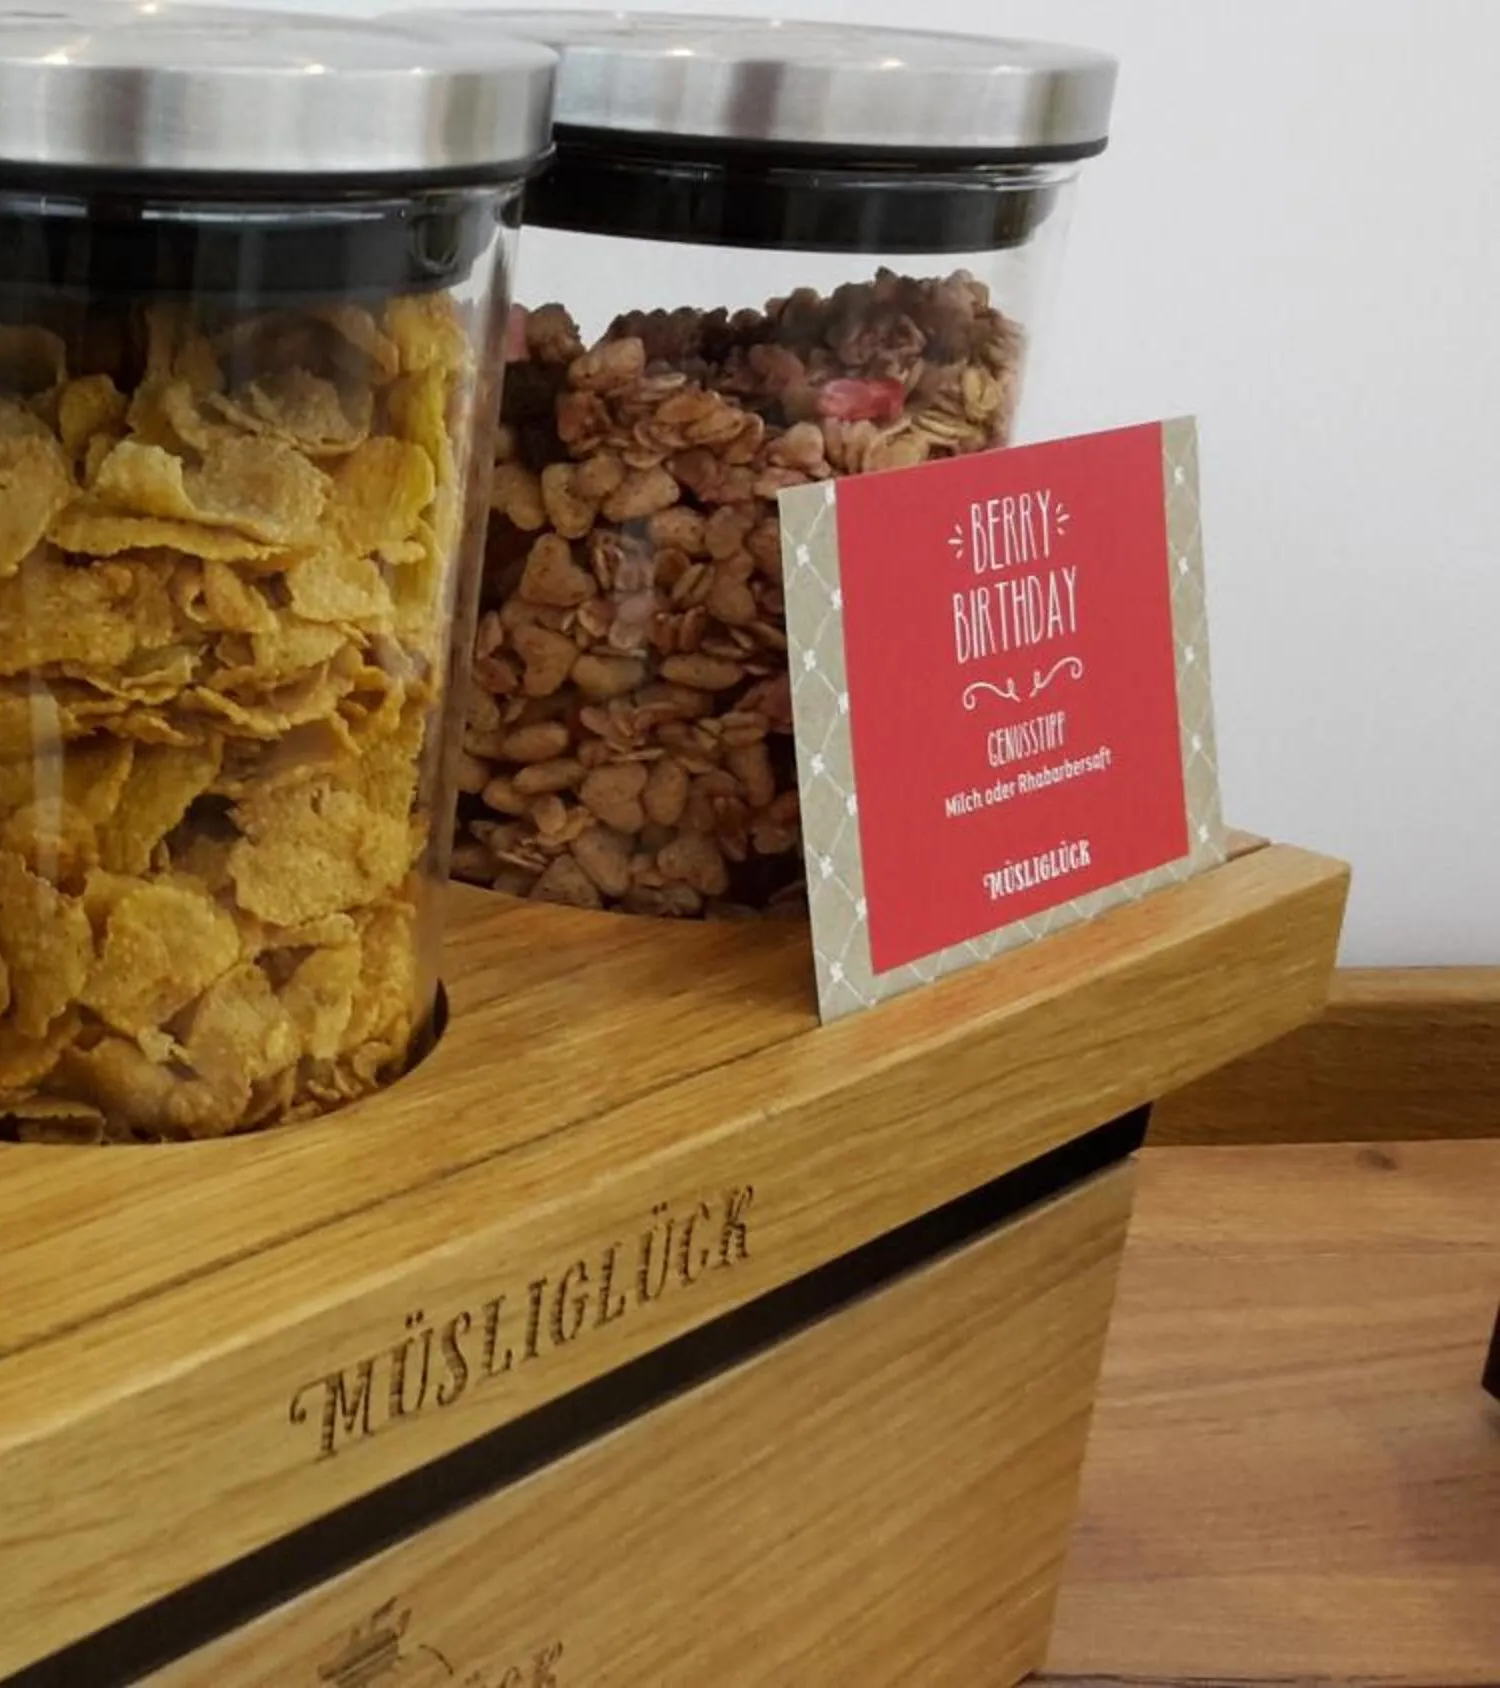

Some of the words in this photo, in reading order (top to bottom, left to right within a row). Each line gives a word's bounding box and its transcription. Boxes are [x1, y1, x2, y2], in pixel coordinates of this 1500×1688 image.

[971, 489, 1051, 575] BERRY
[953, 565, 1077, 664] BIRTHDAY
[987, 710, 1066, 768] GENUSSTIPP
[945, 787, 983, 818] Milch
[985, 777, 1016, 806] oder
[1017, 744, 1113, 794] Rhabarbersaft
[983, 837, 1092, 900] MÜSLIGLÜCK
[289, 1184, 755, 1464] MÜSLIGLÜCK
